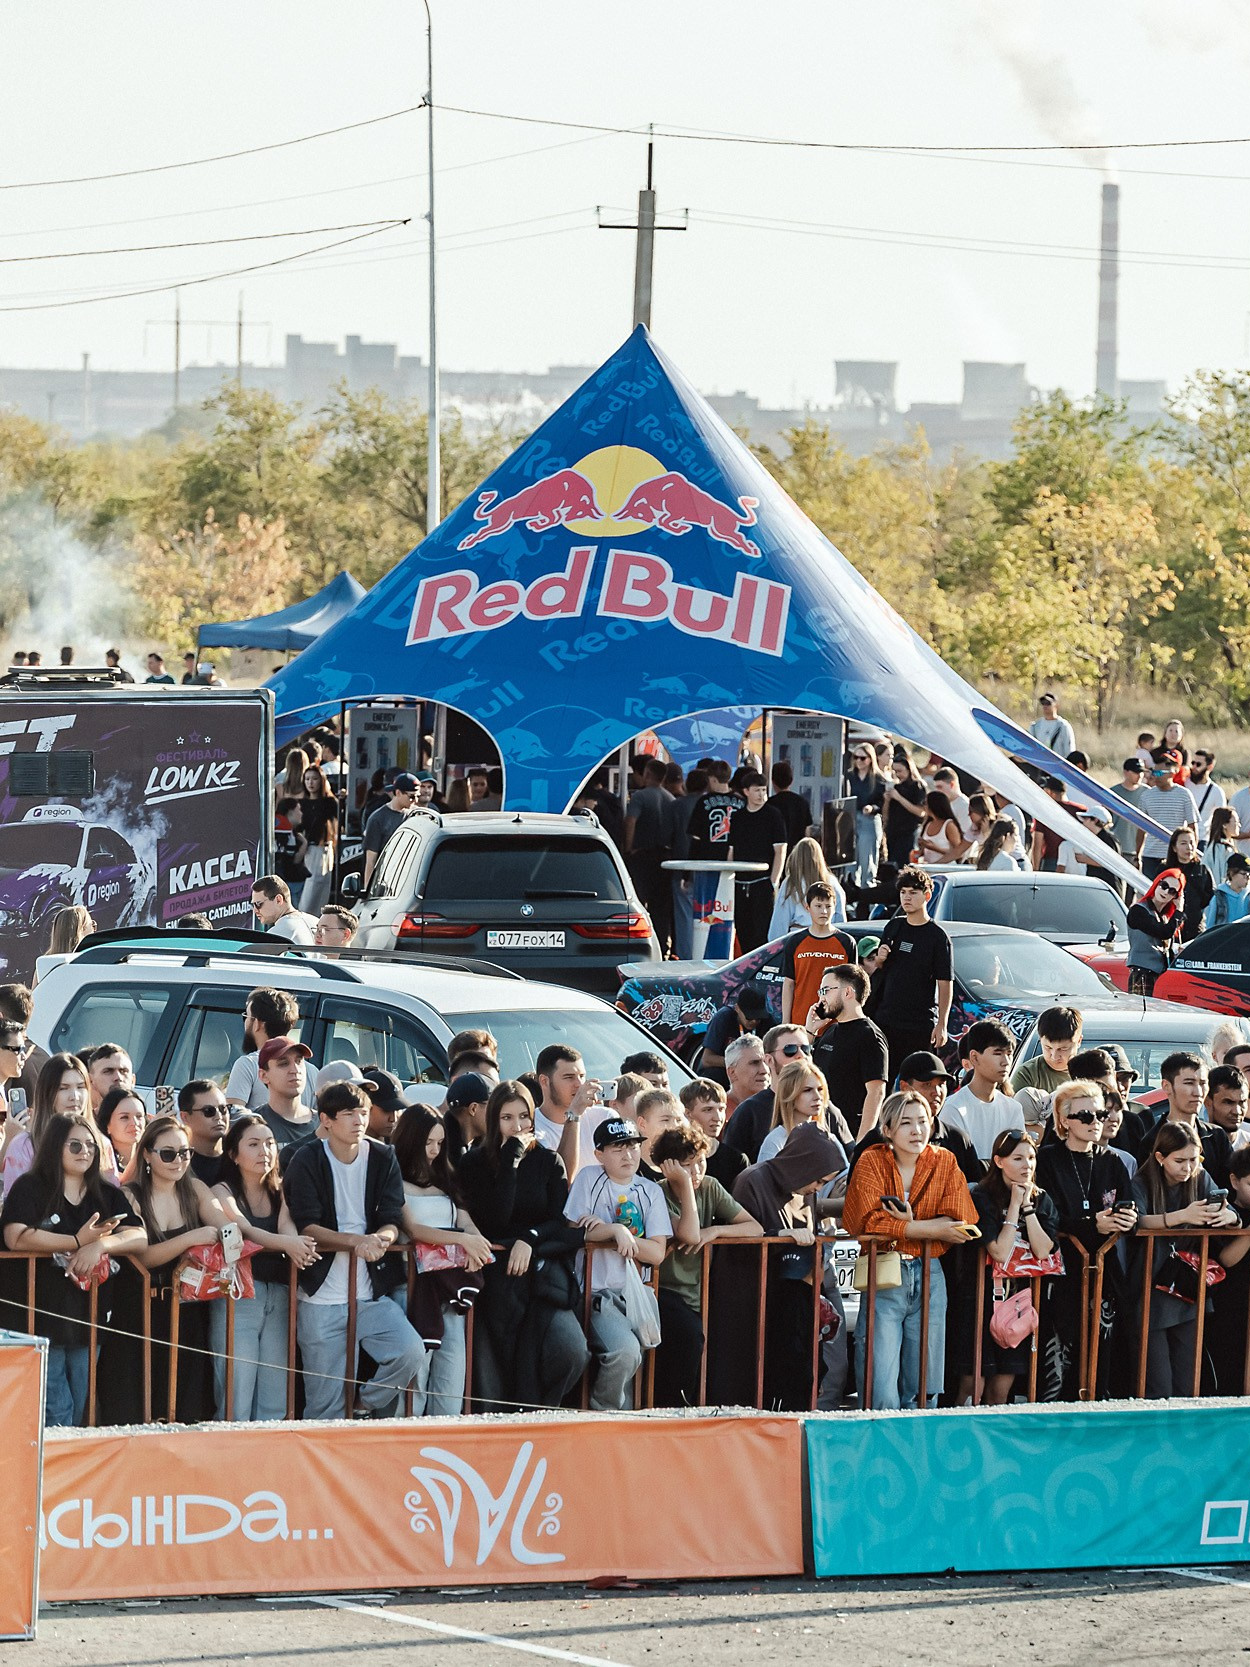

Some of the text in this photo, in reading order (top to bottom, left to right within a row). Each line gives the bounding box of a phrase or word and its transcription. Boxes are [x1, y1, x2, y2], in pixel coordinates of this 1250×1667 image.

[407, 546, 596, 645] Red
[597, 549, 791, 657] Bull
[155, 748, 228, 764] ФЕСТИВАЛЬ
[144, 761, 241, 796] LOW KZ
[43, 808, 71, 817] region
[169, 850, 252, 895] КАССА
[97, 881, 120, 902] region
[169, 883, 249, 913] ПРОДАЖА БИЛЕТОВ
[498, 933, 563, 945] 077 FOX 14
